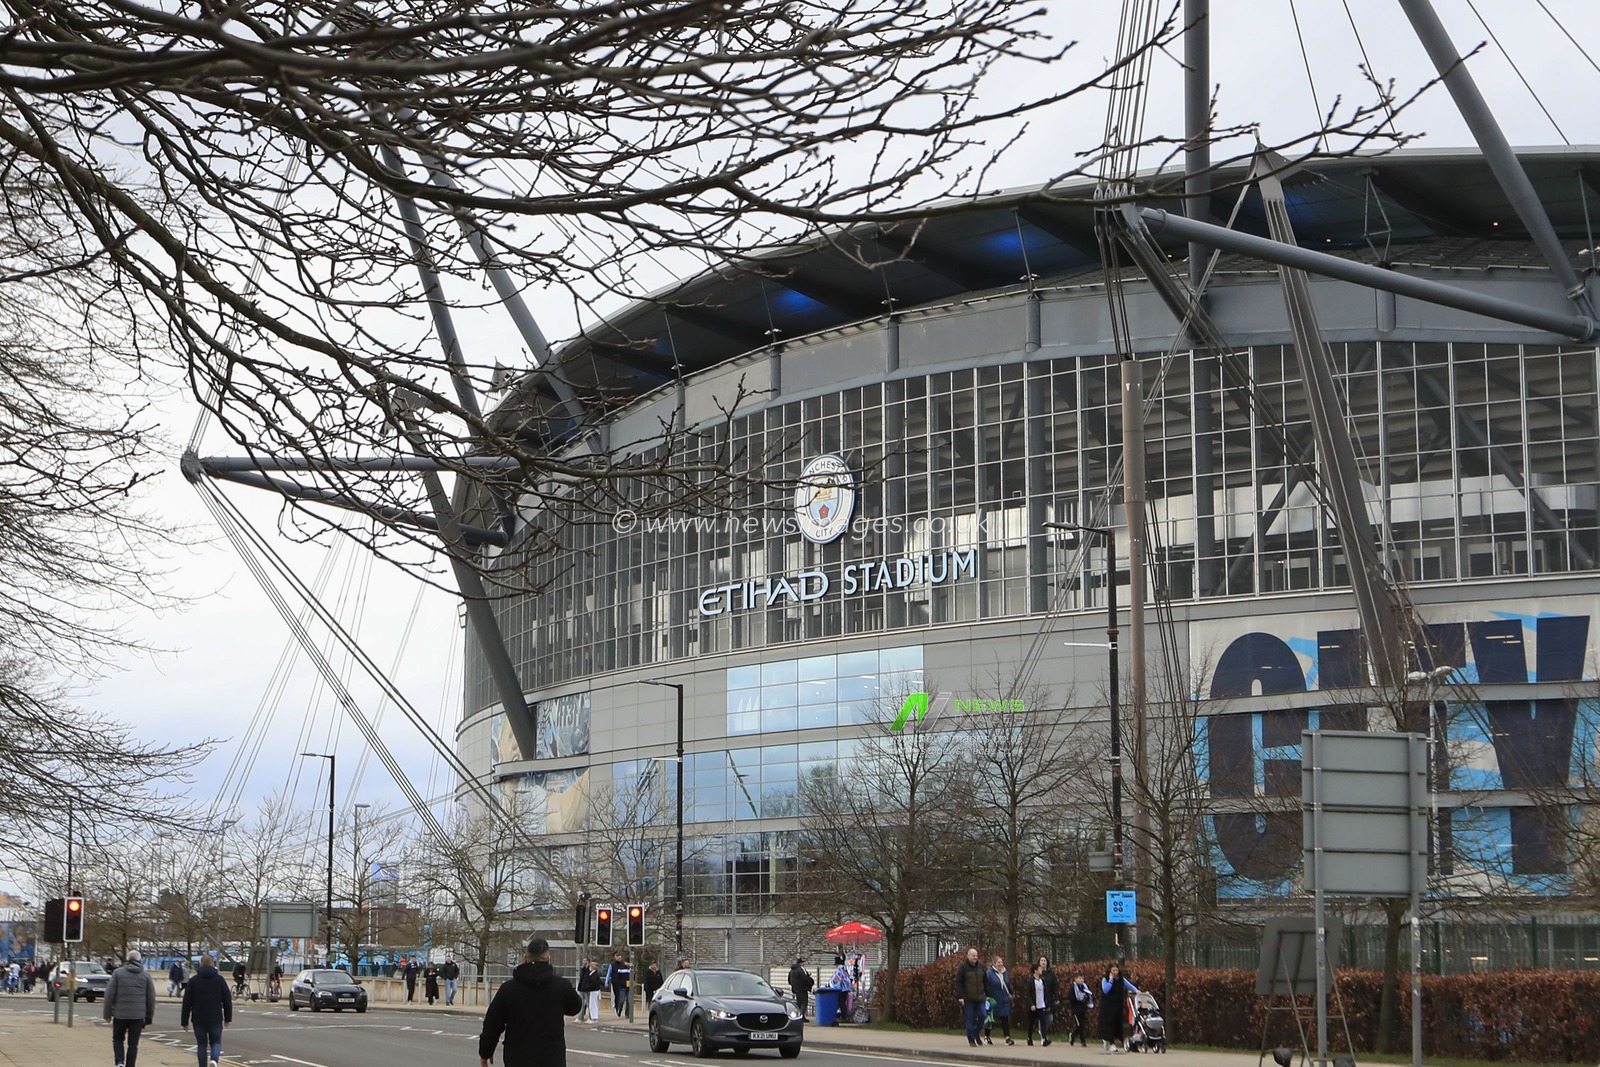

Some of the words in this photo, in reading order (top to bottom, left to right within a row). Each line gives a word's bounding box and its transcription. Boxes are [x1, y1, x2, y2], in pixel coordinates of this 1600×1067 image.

[815, 527, 834, 538] CITY
[700, 571, 829, 616] ETIHAD
[844, 549, 976, 595] STADIUM
